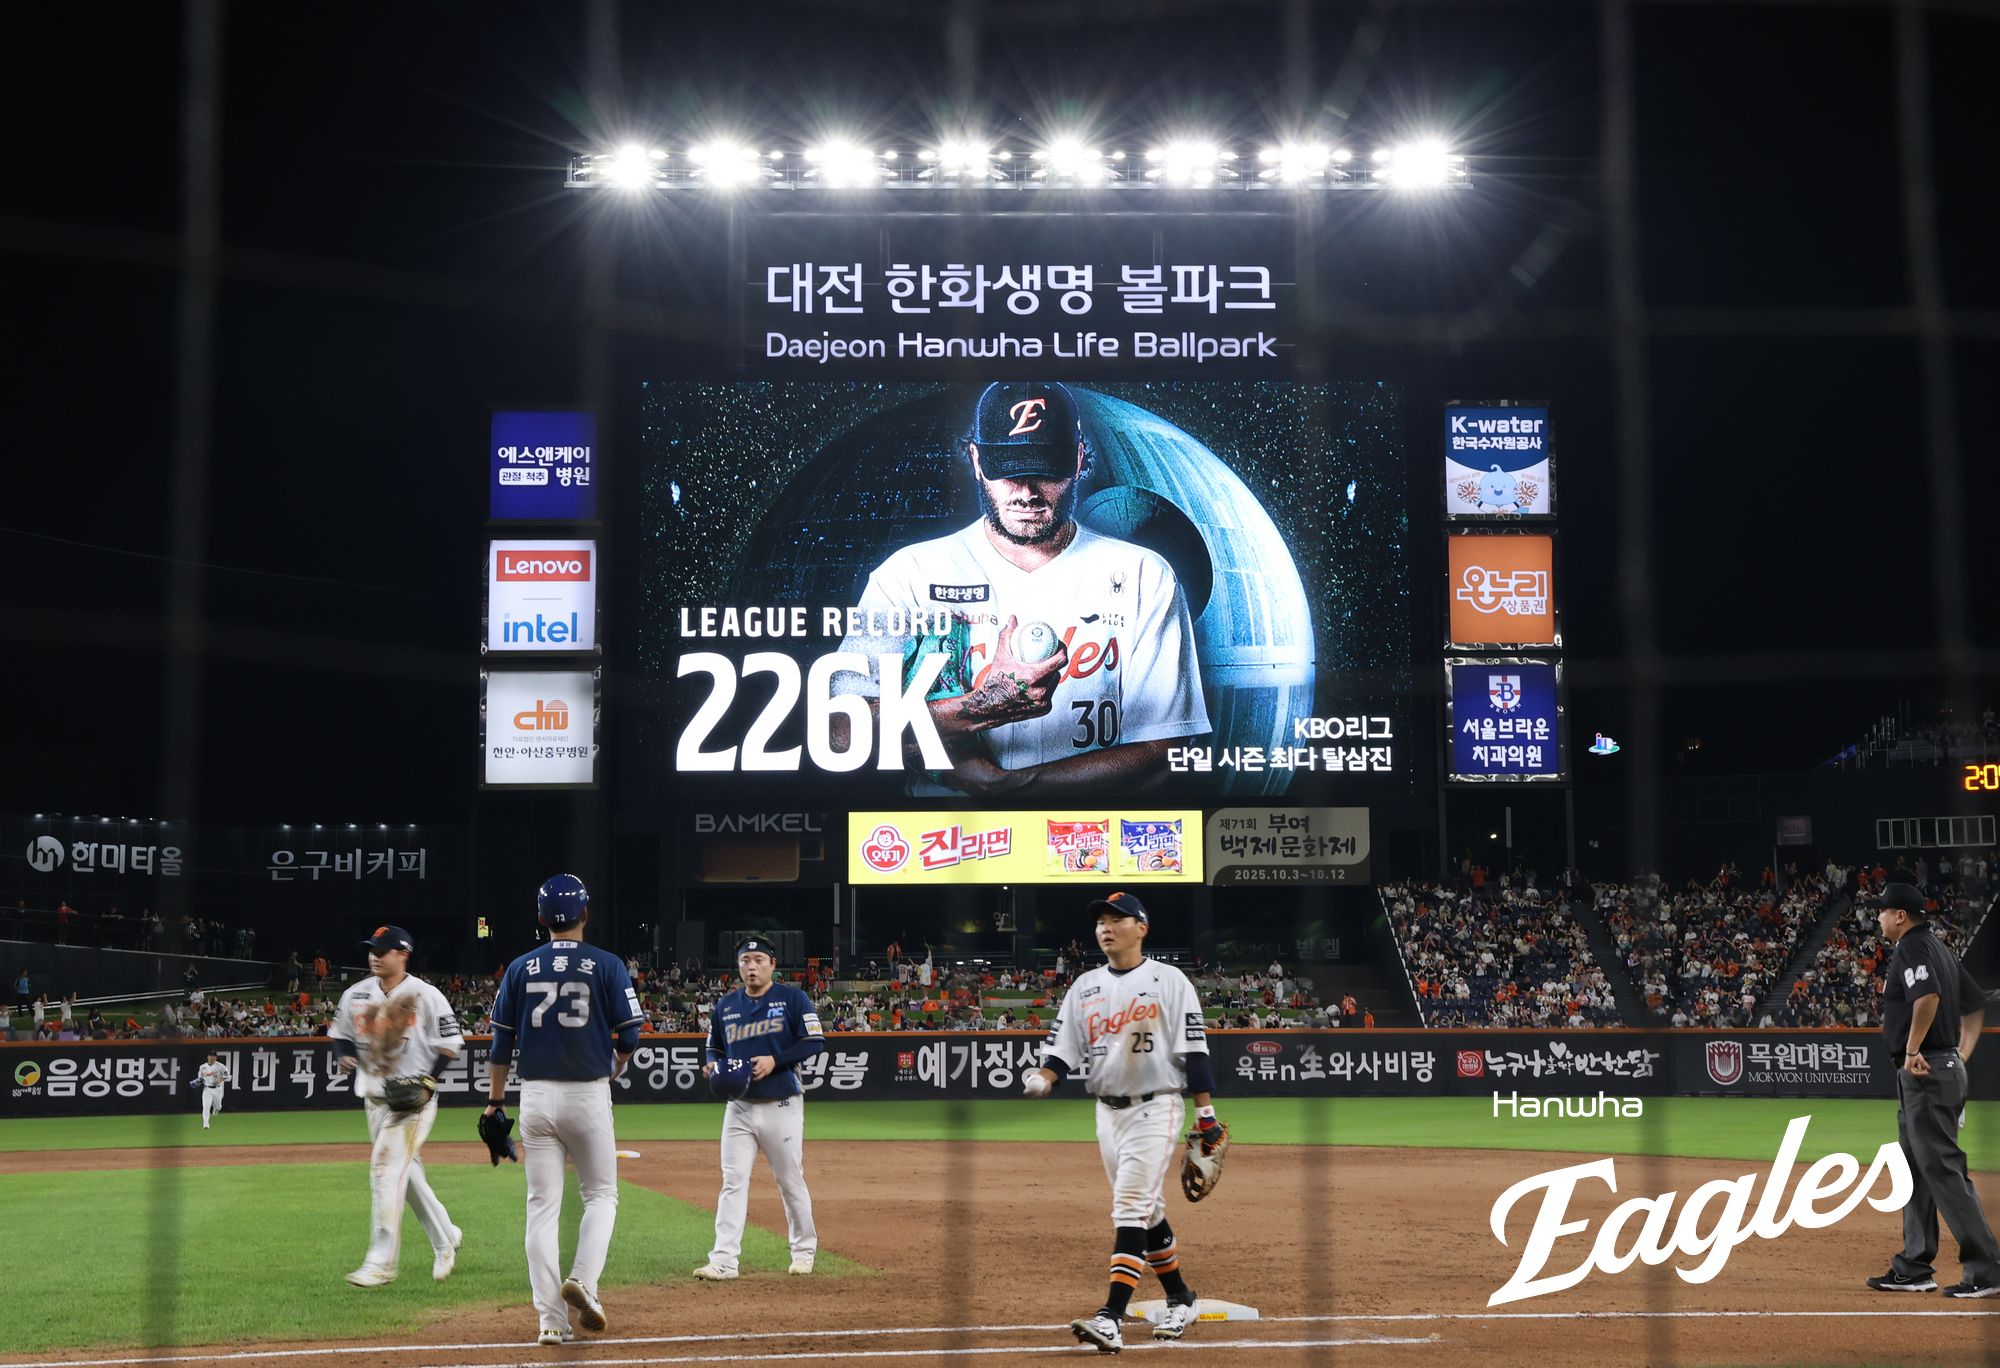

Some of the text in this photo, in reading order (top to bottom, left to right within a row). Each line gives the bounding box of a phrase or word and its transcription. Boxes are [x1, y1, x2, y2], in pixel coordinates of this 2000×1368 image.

[766, 263, 1276, 315] 대전 한화생명 볼파크
[766, 331, 1278, 364] Daejeon Hanwha Life Ballpark
[1452, 416, 1543, 433] K-water
[1452, 437, 1542, 450] 한국수자원공사
[497, 446, 590, 467] 에스앤케이
[556, 467, 590, 486] 병원
[504, 556, 582, 575] Lenovo
[934, 587, 986, 601] 한화생명
[1503, 601, 1545, 614] 상품권
[504, 612, 579, 643] intel
[680, 607, 952, 637] LEAGUE RECORD
[676, 652, 955, 772] 226K
[1071, 700, 1118, 748] 30
[1294, 716, 1393, 740] KBO리그
[1463, 717, 1549, 740] 서울브라운
[1167, 746, 1393, 771] 단일 시즌 최다 탈삼진
[1472, 746, 1542, 767] 치과의원
[1964, 764, 2000, 791] 2:0
[695, 813, 822, 833] BAMKEL
[1219, 813, 1310, 834] 제71회 부여
[871, 849, 901, 864] 오뚜기
[919, 825, 1012, 870] 진라면
[1220, 835, 1356, 858] 백제문화제
[71, 842, 183, 876] 한미타올
[267, 848, 426, 881] 은구비커피
[555, 914, 566, 922] 73
[526, 982, 590, 1028] 73
[1087, 997, 1159, 1045] Eagles
[1131, 1032, 1154, 1053] 25
[1747, 1043, 1870, 1071] 목원대학교
[47, 1058, 180, 1097] 음성명작
[1806, 1072, 1871, 1083] UNIVERSITY
